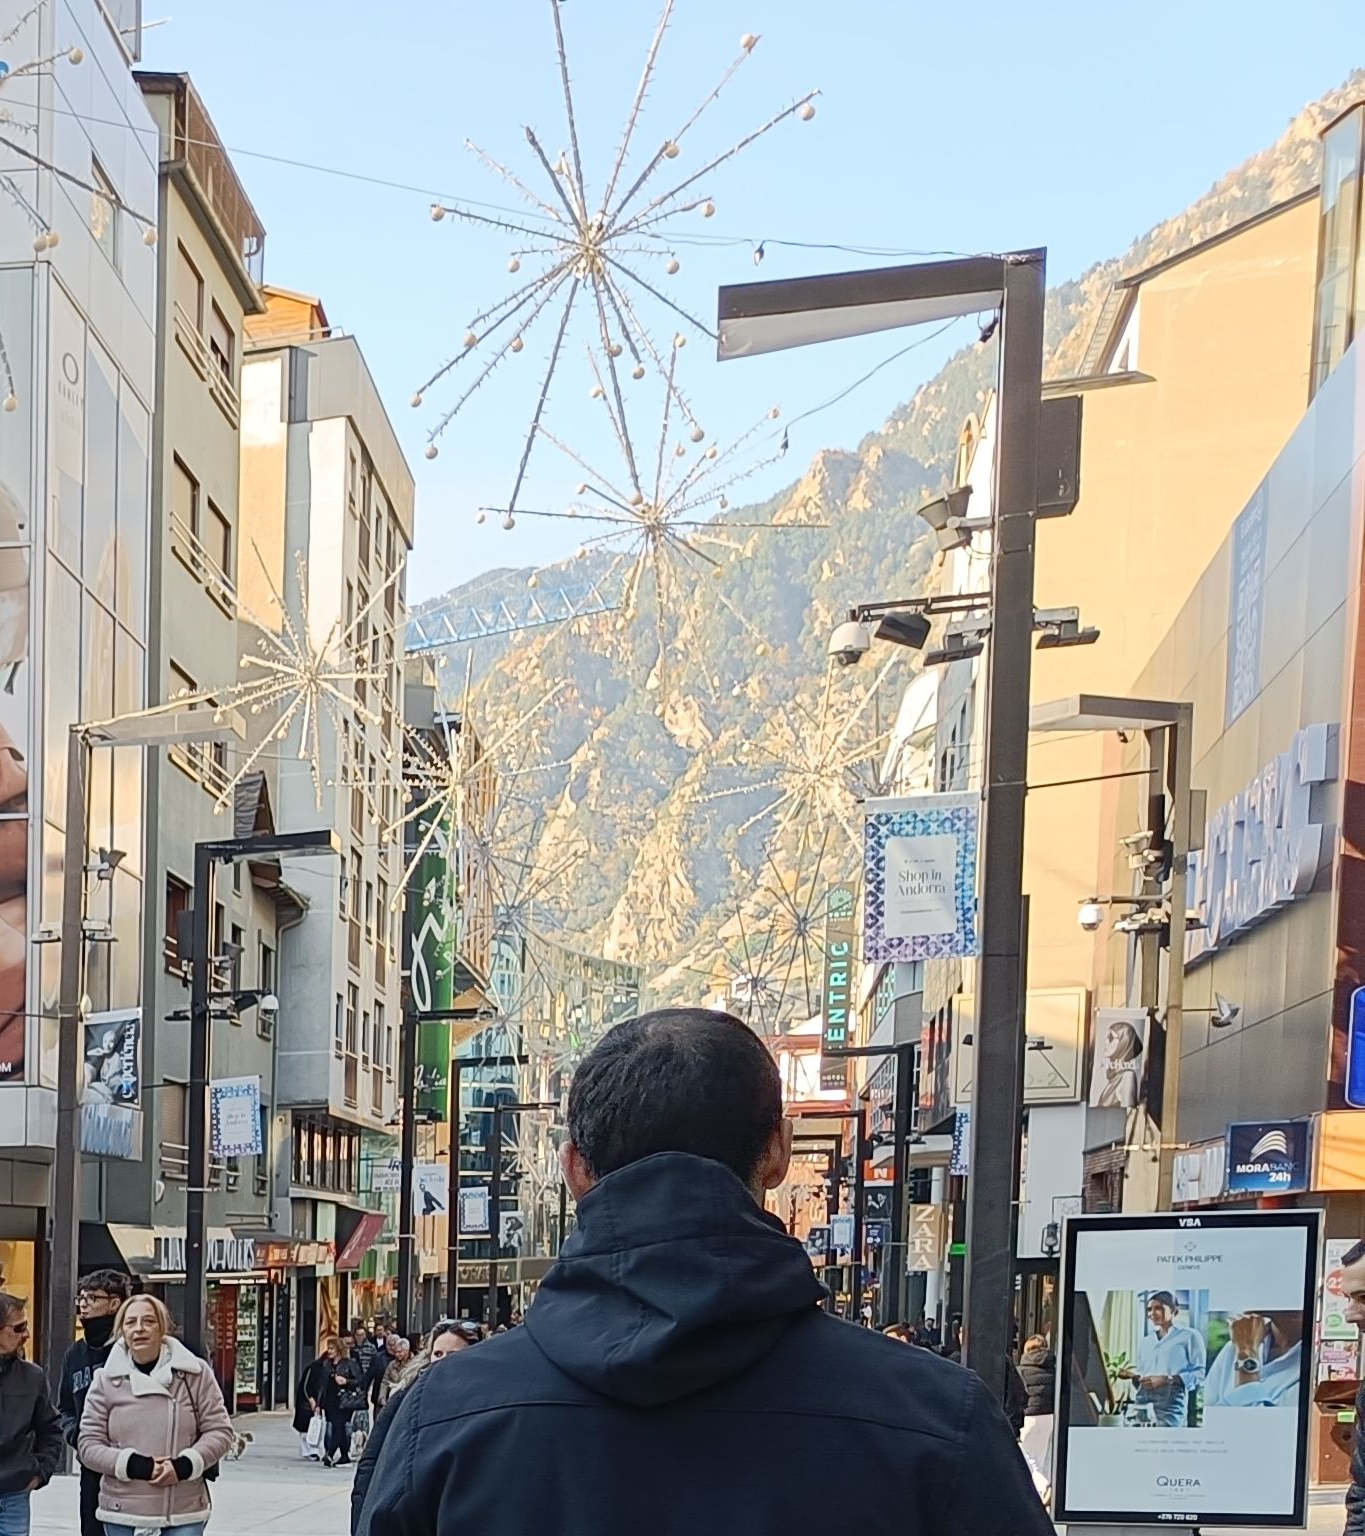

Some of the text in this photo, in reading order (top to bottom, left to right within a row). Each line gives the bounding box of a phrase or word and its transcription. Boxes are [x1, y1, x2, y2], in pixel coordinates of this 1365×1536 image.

[898, 866, 942, 884] Shop in
[895, 882, 946, 897] Andorra
[1269, 1171, 1291, 1183] 24h
[912, 1206, 937, 1270] ZARA
[1185, 1254, 1223, 1263] PHILIPPE
